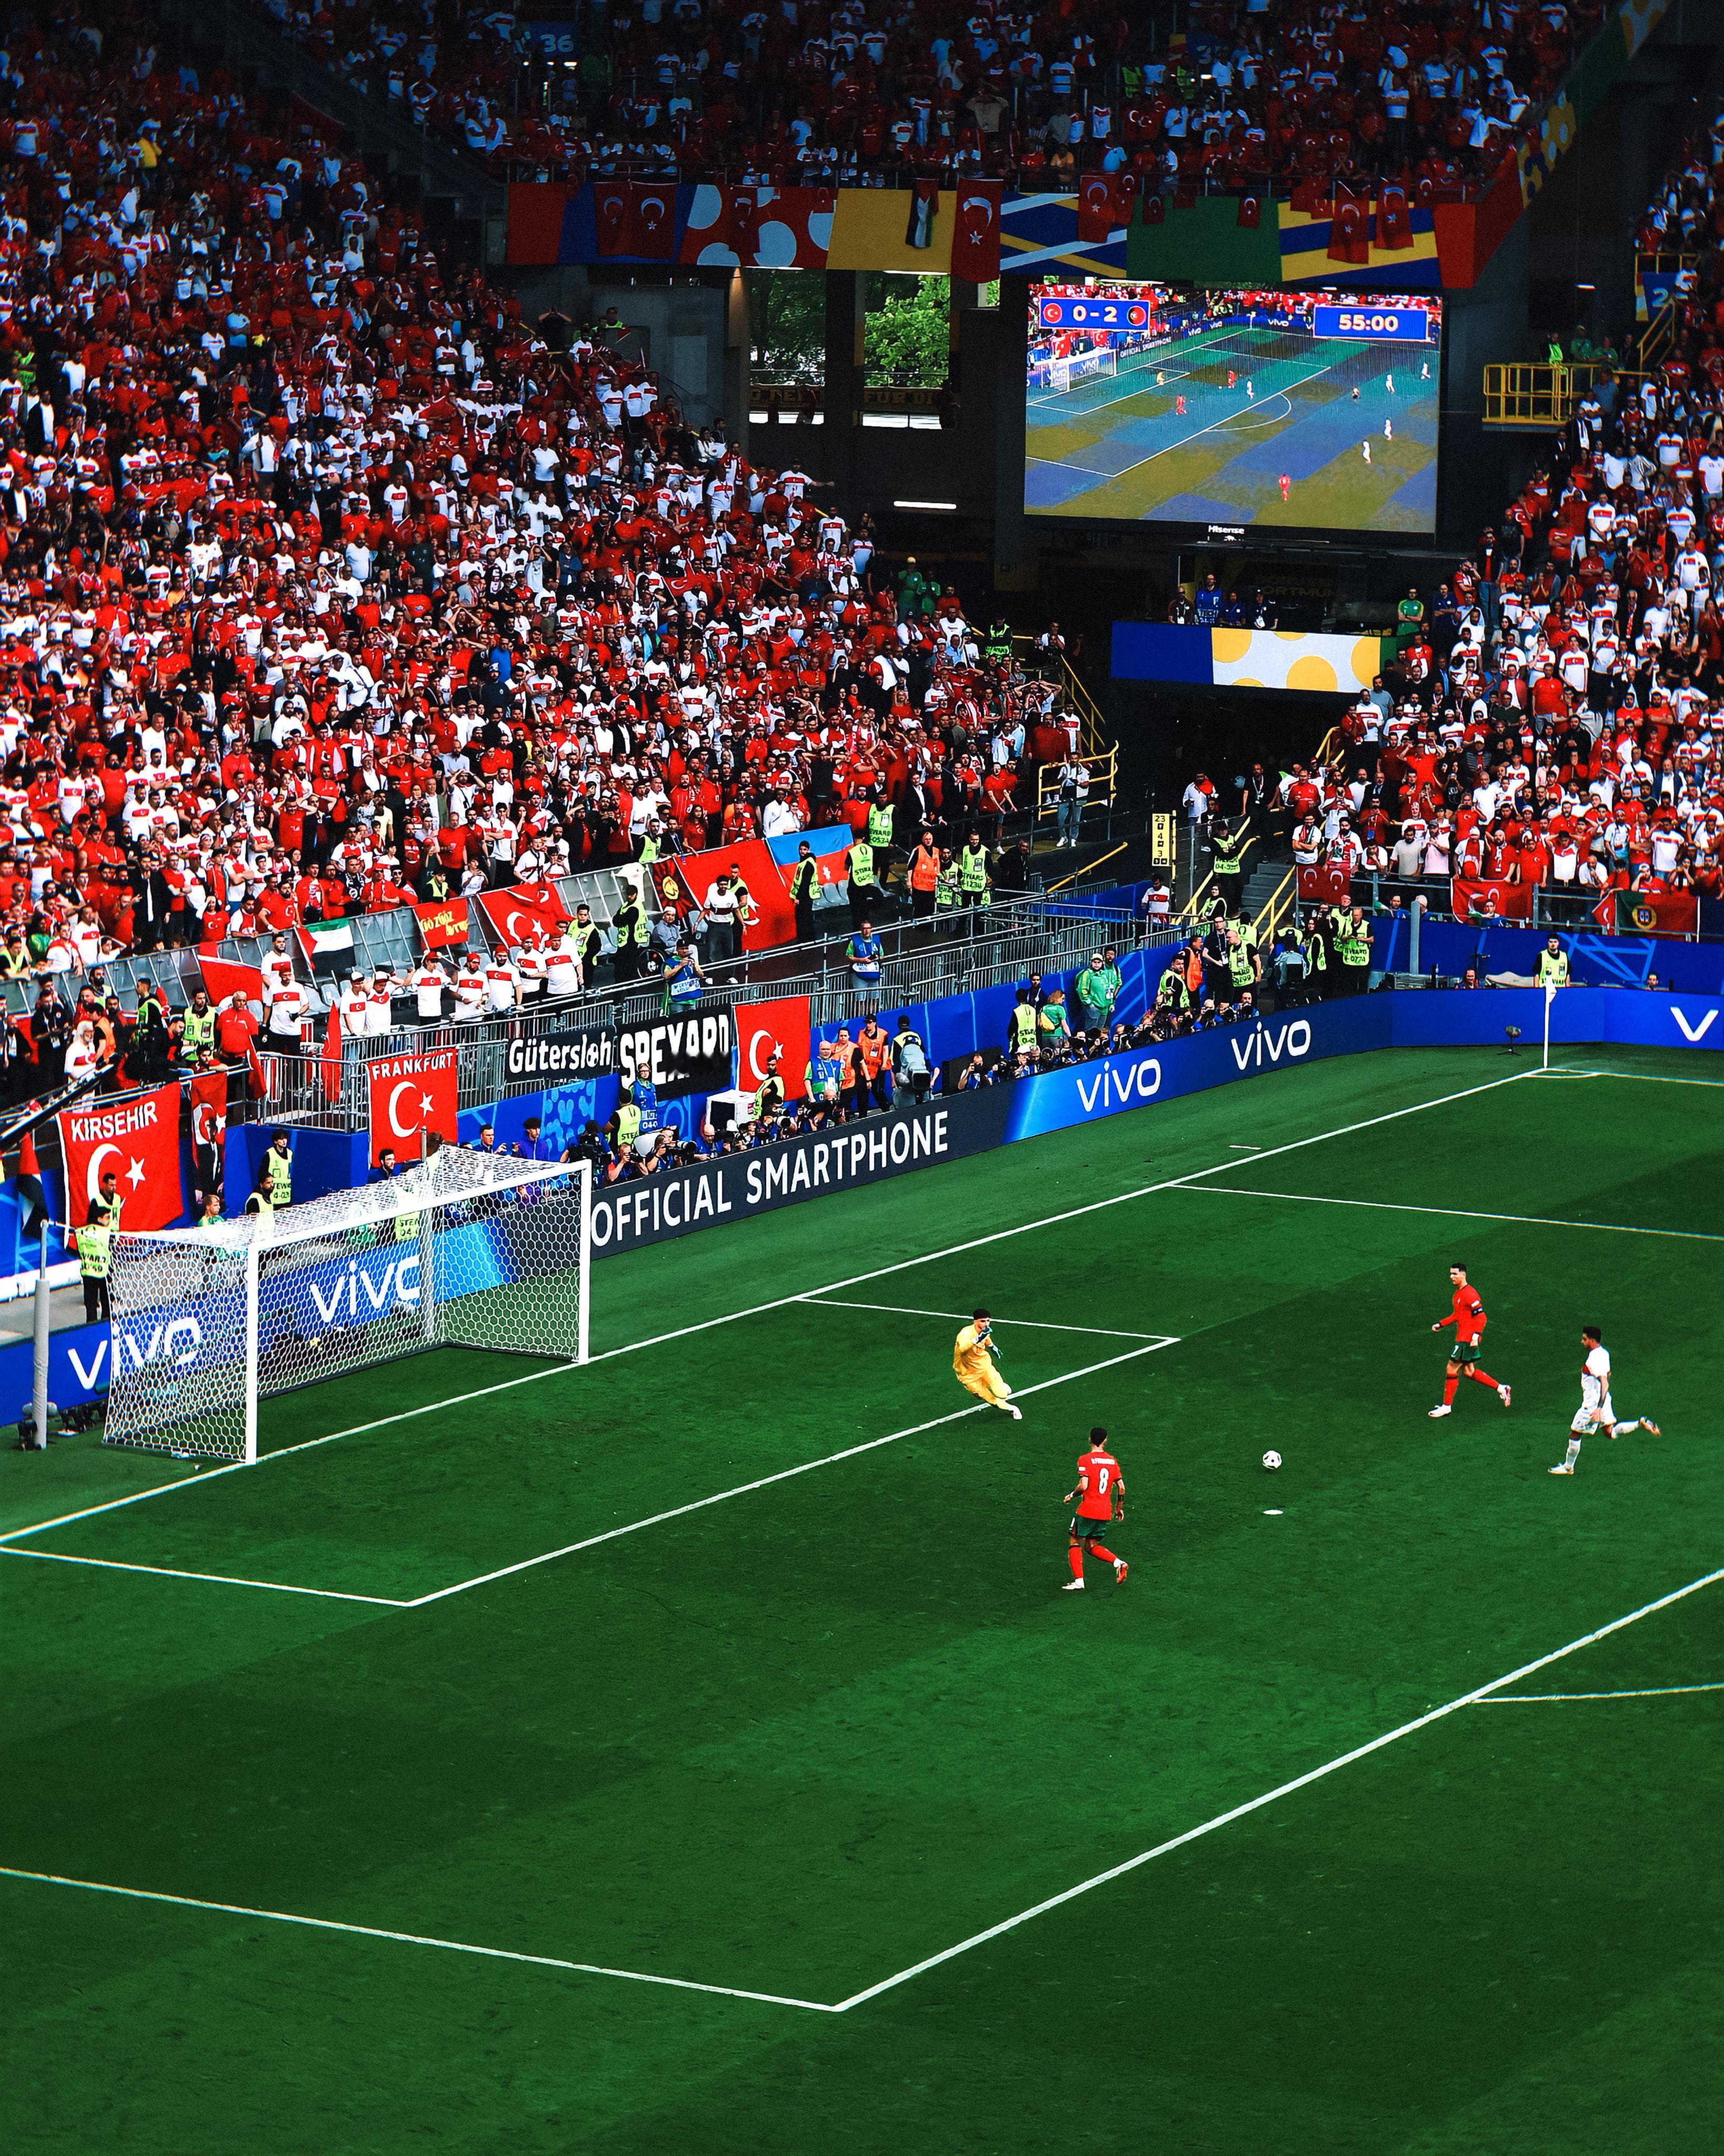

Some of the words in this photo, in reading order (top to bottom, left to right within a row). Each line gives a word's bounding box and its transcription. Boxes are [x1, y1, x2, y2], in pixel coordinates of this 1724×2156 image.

[539, 34, 574, 53] 36
[1339, 314, 1399, 332] 55:00
[1208, 525, 1245, 534] Hisense
[509, 1032, 611, 1073] Gütersloh
[1231, 1020, 1311, 1071] vivo
[372, 1052, 453, 1081] FRANKFURT
[1076, 1059, 1161, 1112] vivo
[71, 1101, 158, 1142] KIRSEHIR
[591, 1171, 732, 1246] OFFICIAL
[746, 1111, 949, 1204] SMARTPHONE
[67, 1317, 202, 1390] vivo
[1098, 1468, 1109, 1494] 8
